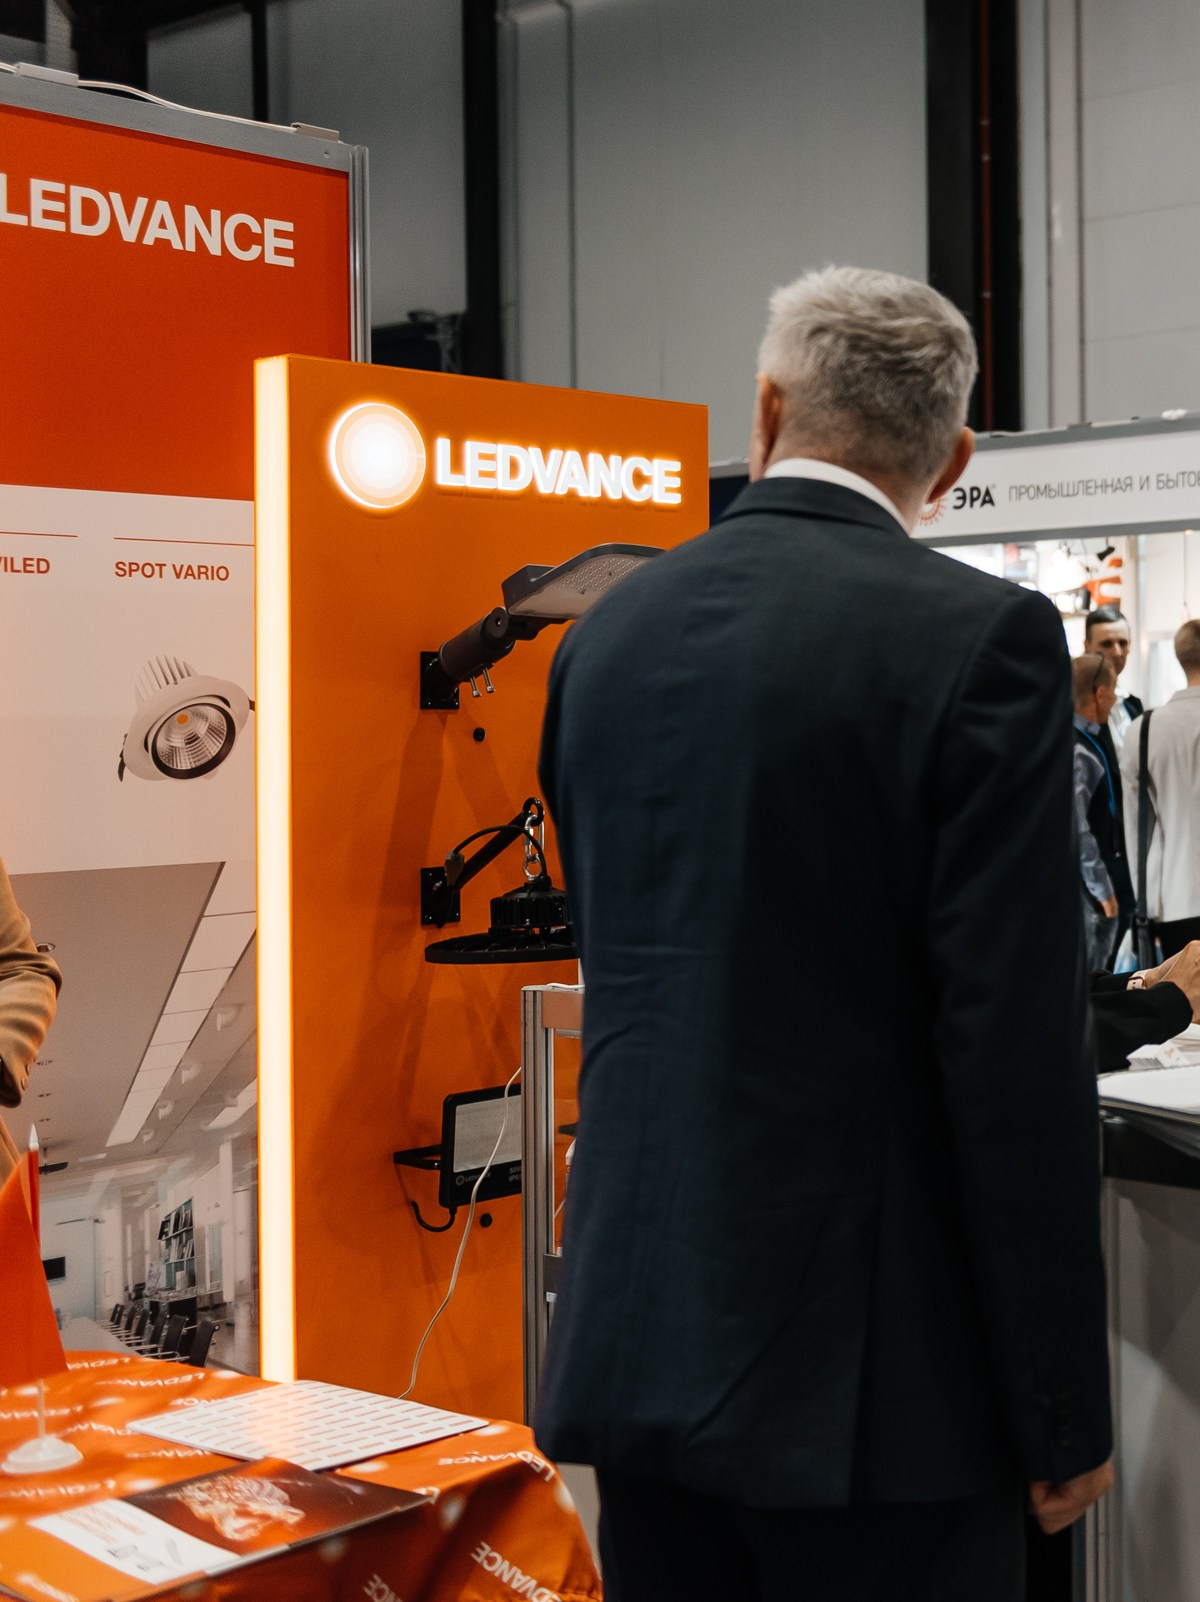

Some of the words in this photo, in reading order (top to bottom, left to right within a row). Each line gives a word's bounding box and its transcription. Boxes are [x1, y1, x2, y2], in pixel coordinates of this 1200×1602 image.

[0, 172, 295, 267] LEDVANCE
[436, 437, 682, 504] LEDVANCE
[952, 486, 996, 510] ЭРА
[1008, 476, 1133, 503] ПРОМЫШЛЕННАЯ
[1139, 475, 1150, 492] И
[0, 557, 51, 575] ILED
[114, 561, 167, 579] SPOT
[172, 563, 230, 582] VARIO
